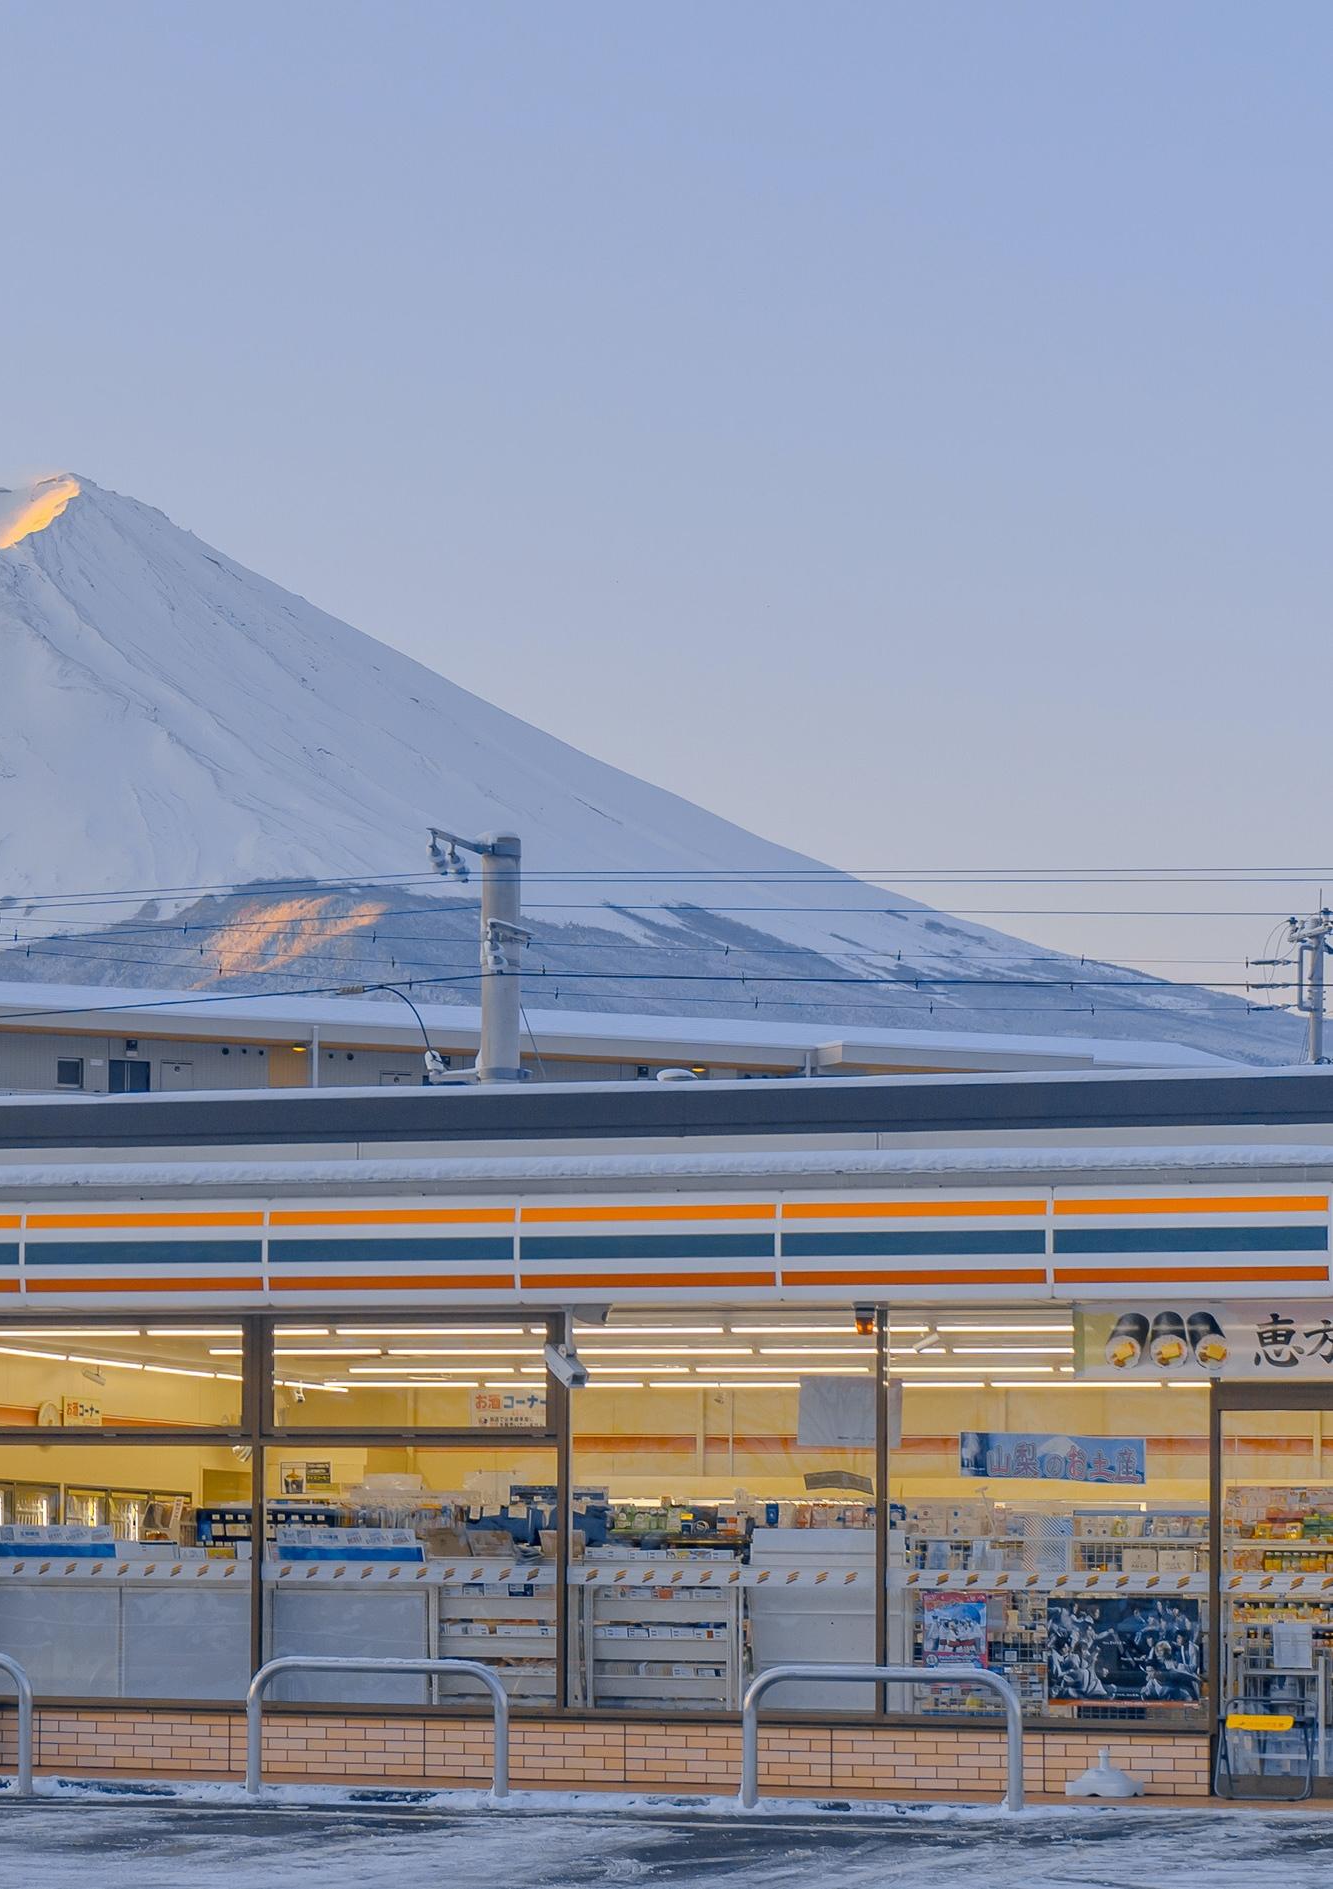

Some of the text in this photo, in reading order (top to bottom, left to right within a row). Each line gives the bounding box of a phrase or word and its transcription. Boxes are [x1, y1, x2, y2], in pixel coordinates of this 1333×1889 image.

[986, 1441, 1142, 1484] 山梨のお土産
